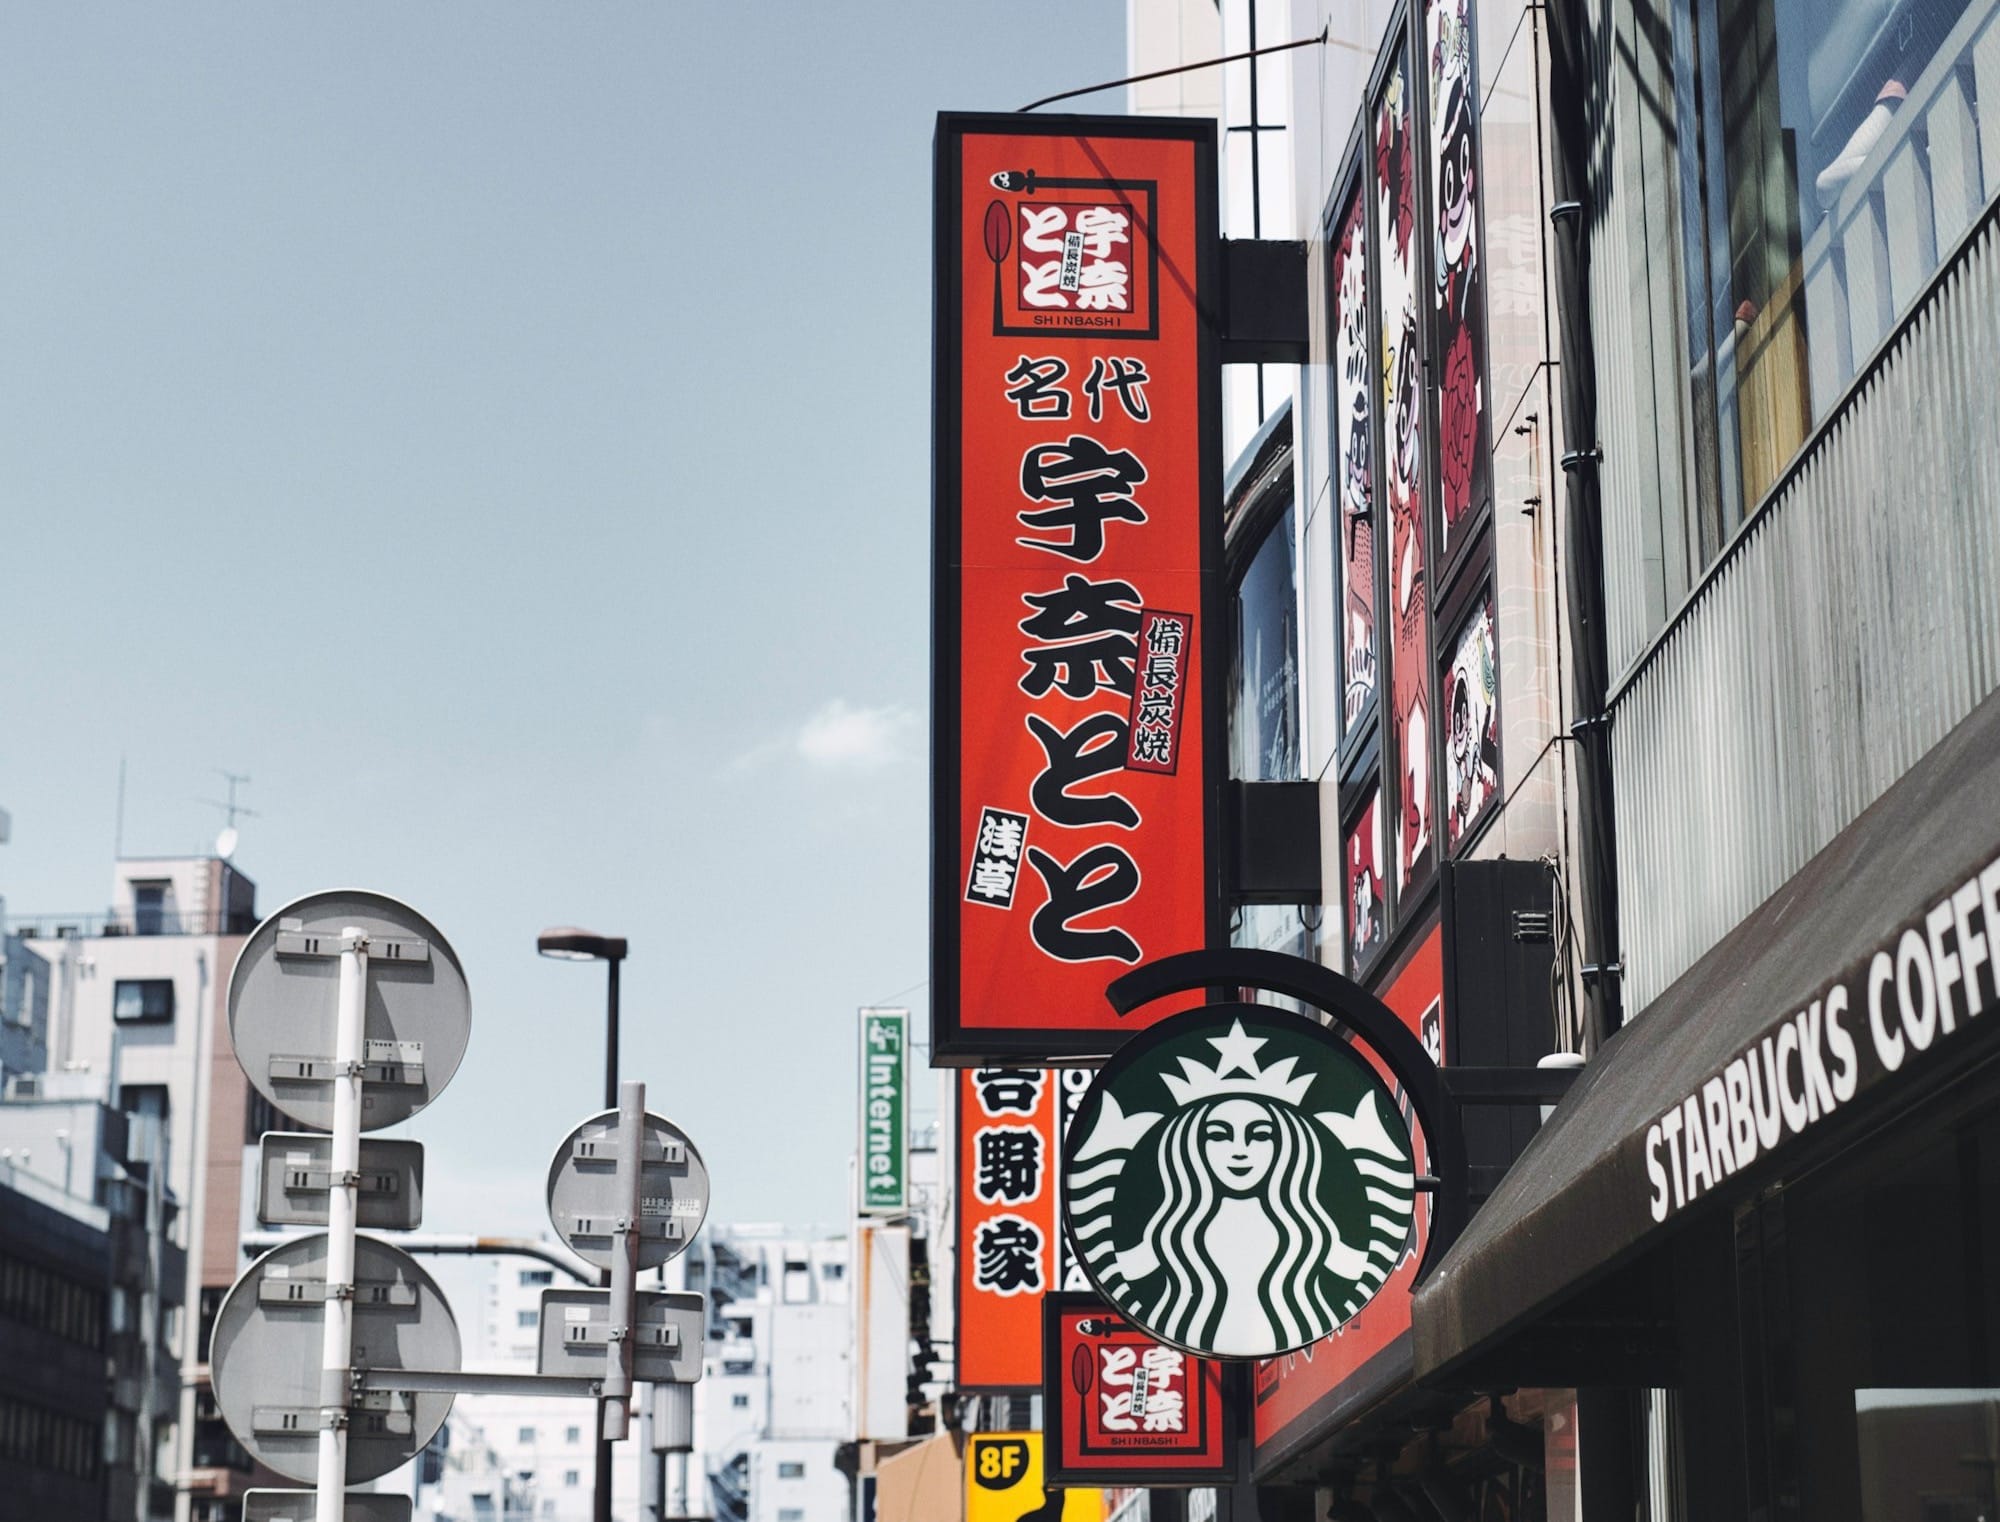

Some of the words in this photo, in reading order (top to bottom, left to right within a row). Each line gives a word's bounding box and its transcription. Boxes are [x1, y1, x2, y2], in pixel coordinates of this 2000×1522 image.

[1033, 314, 1122, 327] SHINBASHI
[1004, 354, 1151, 423] 名代
[1015, 433, 1149, 965] 宇奈とと
[1133, 616, 1184, 765] 備長炭焼
[971, 815, 1023, 898] 浅草
[868, 1053, 898, 1190] Internet
[1645, 984, 1858, 1223] STARBUCKS
[979, 1445, 1022, 1479] 8F
[1111, 1437, 1179, 1446] SHINBASHI
